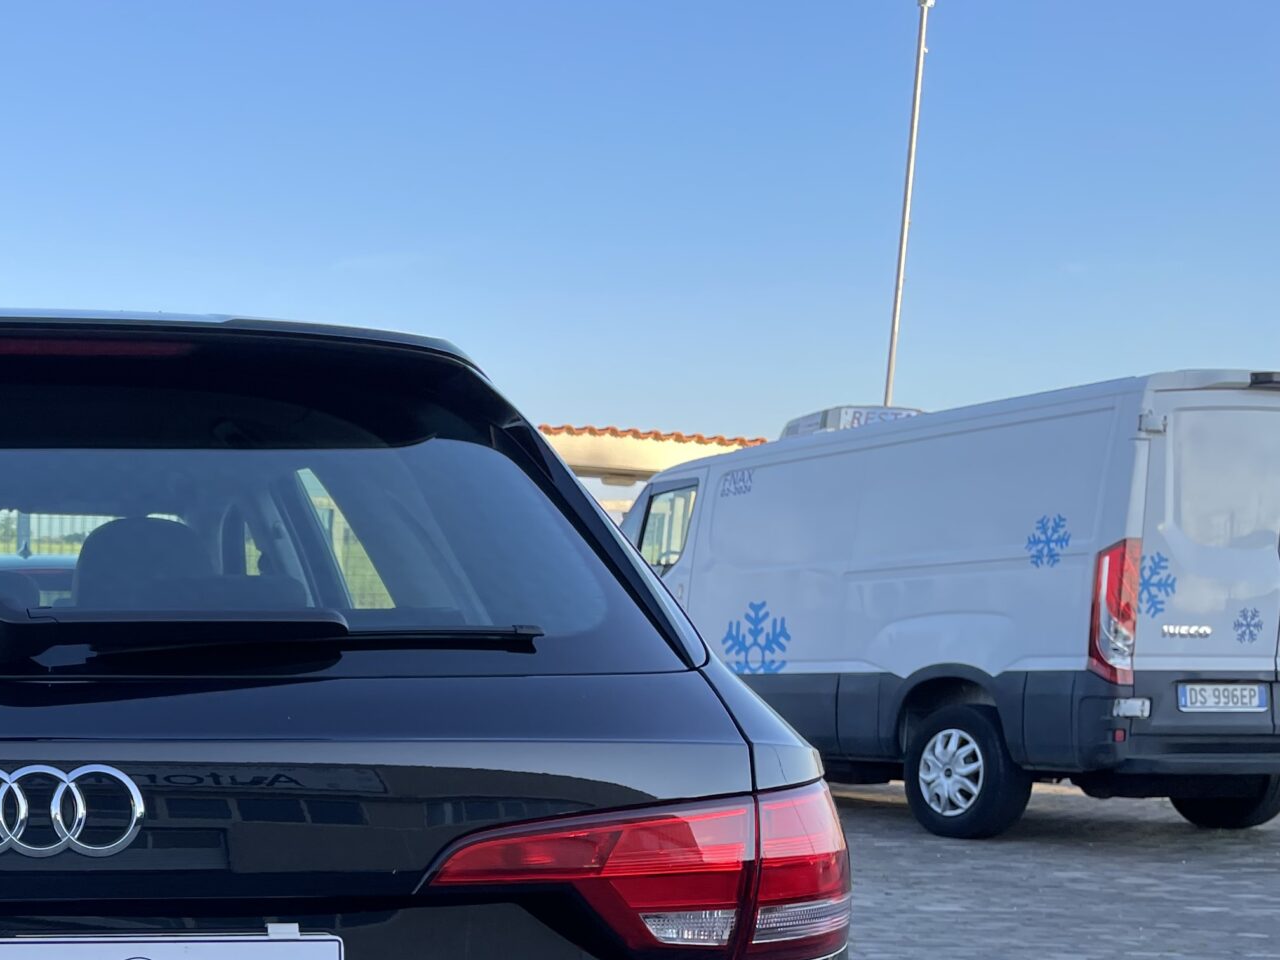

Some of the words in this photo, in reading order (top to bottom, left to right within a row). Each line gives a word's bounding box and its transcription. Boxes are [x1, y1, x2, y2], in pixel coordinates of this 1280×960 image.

[1162, 625, 1213, 636] IVECO
[1189, 687, 1207, 706] DS
[1212, 687, 1257, 706] 996EP
